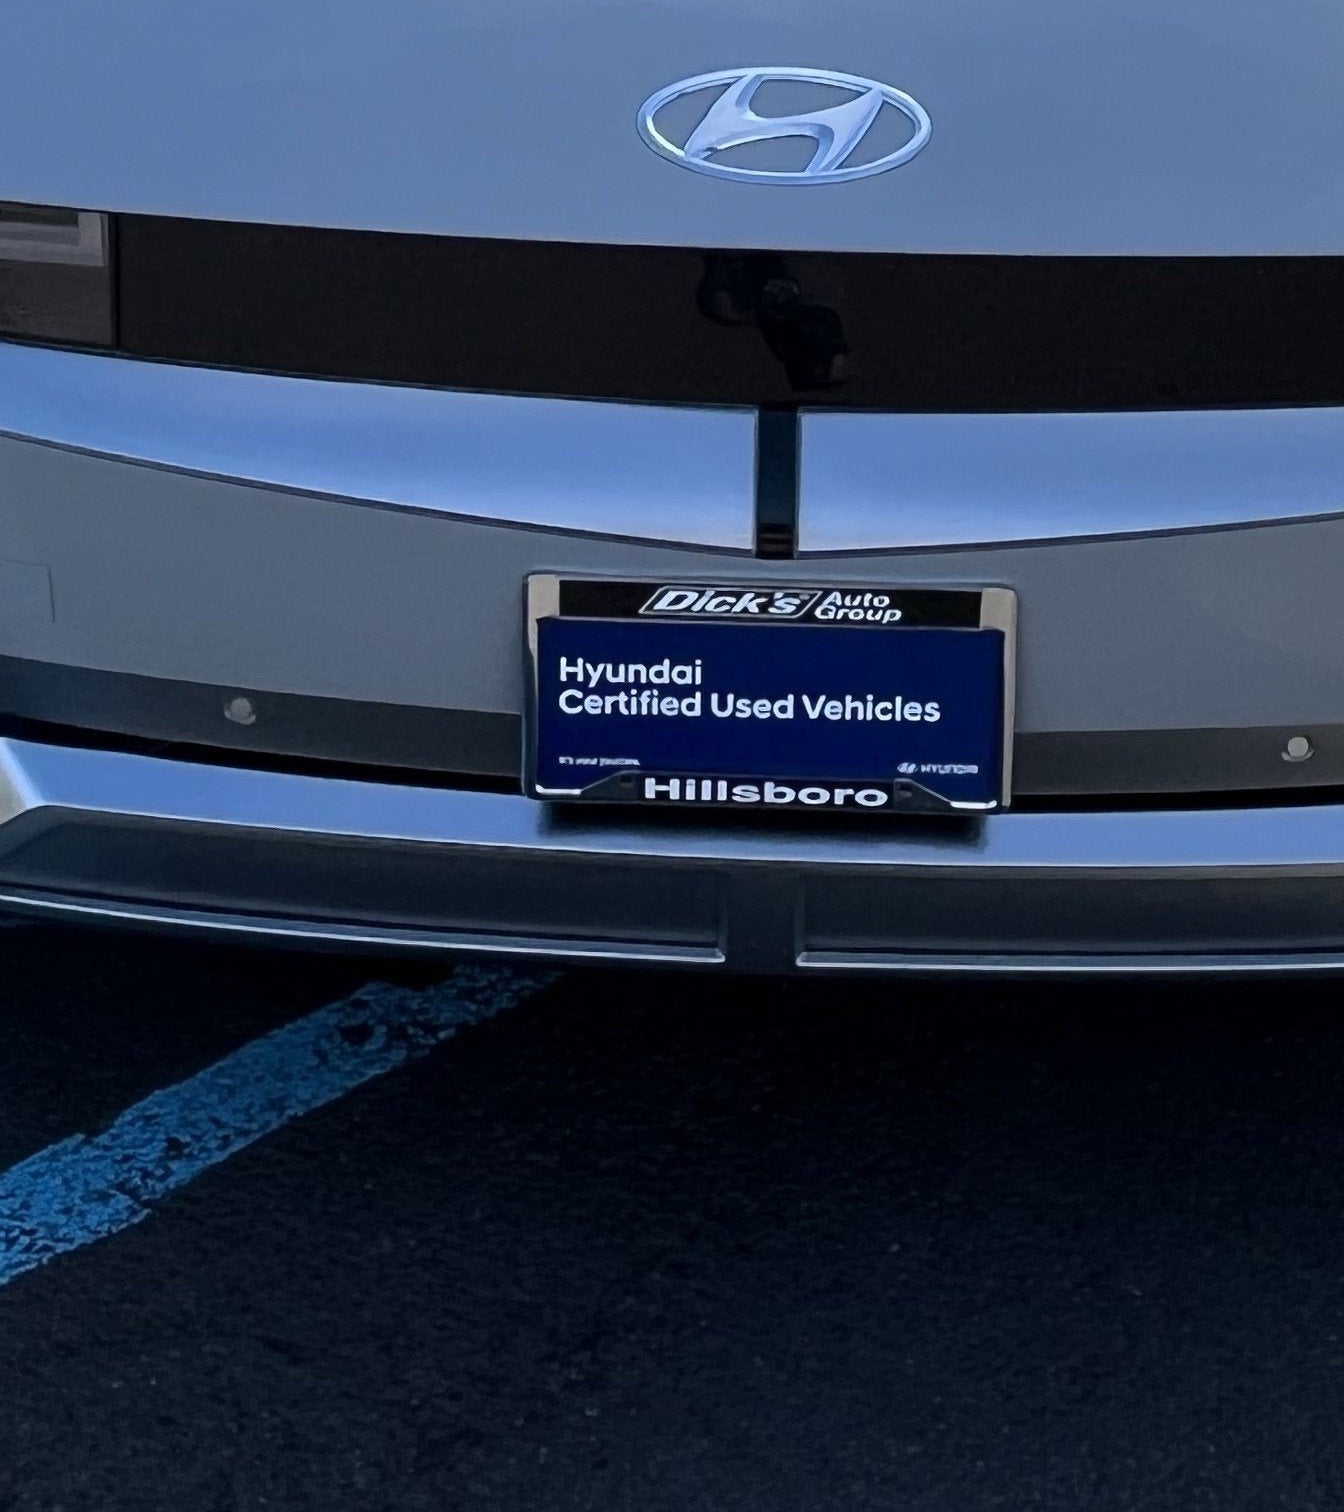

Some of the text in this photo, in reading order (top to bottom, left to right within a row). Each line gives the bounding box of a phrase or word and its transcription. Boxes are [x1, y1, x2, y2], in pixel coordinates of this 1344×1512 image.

[814, 605, 902, 624] Group
[820, 591, 890, 608] Auto
[559, 657, 702, 687] Hyundai
[559, 689, 941, 722] Certified Used Vehicles
[644, 777, 888, 807] Hillsboro
